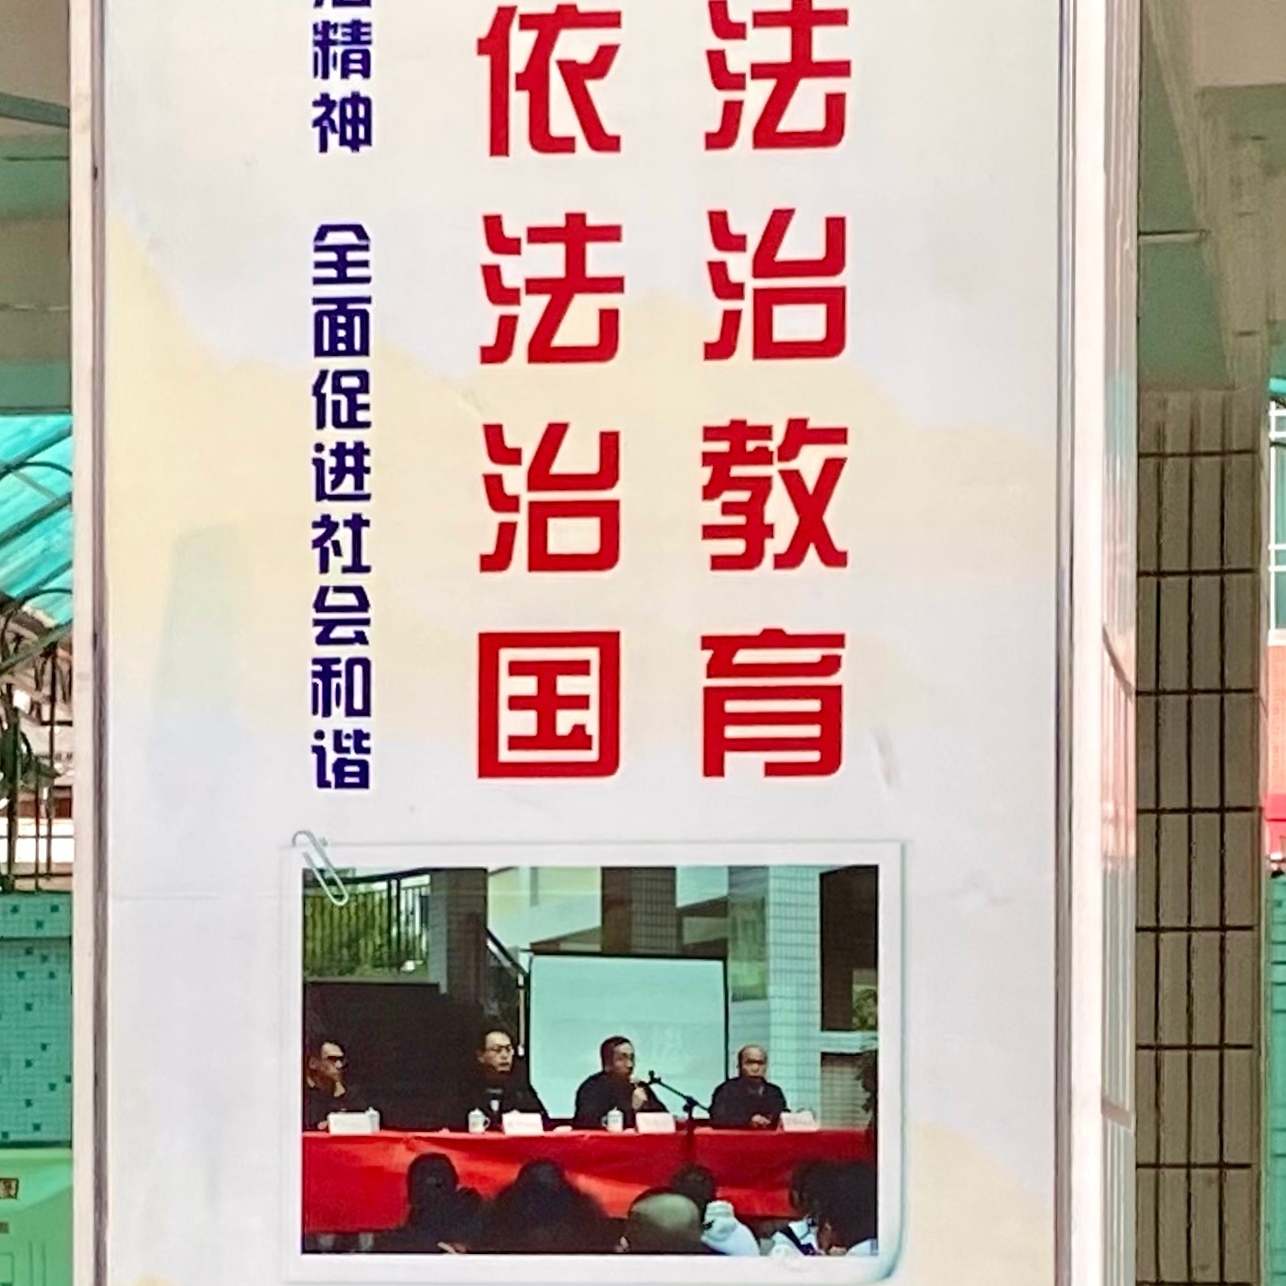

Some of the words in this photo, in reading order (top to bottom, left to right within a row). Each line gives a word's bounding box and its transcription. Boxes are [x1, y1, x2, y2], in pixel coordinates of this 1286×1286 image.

[312, 0, 372, 152] 精神
[476, 2, 624, 779] 依法治国
[700, 0, 851, 779] 法治教育
[312, 223, 372, 790] 全面促进社会和谐
